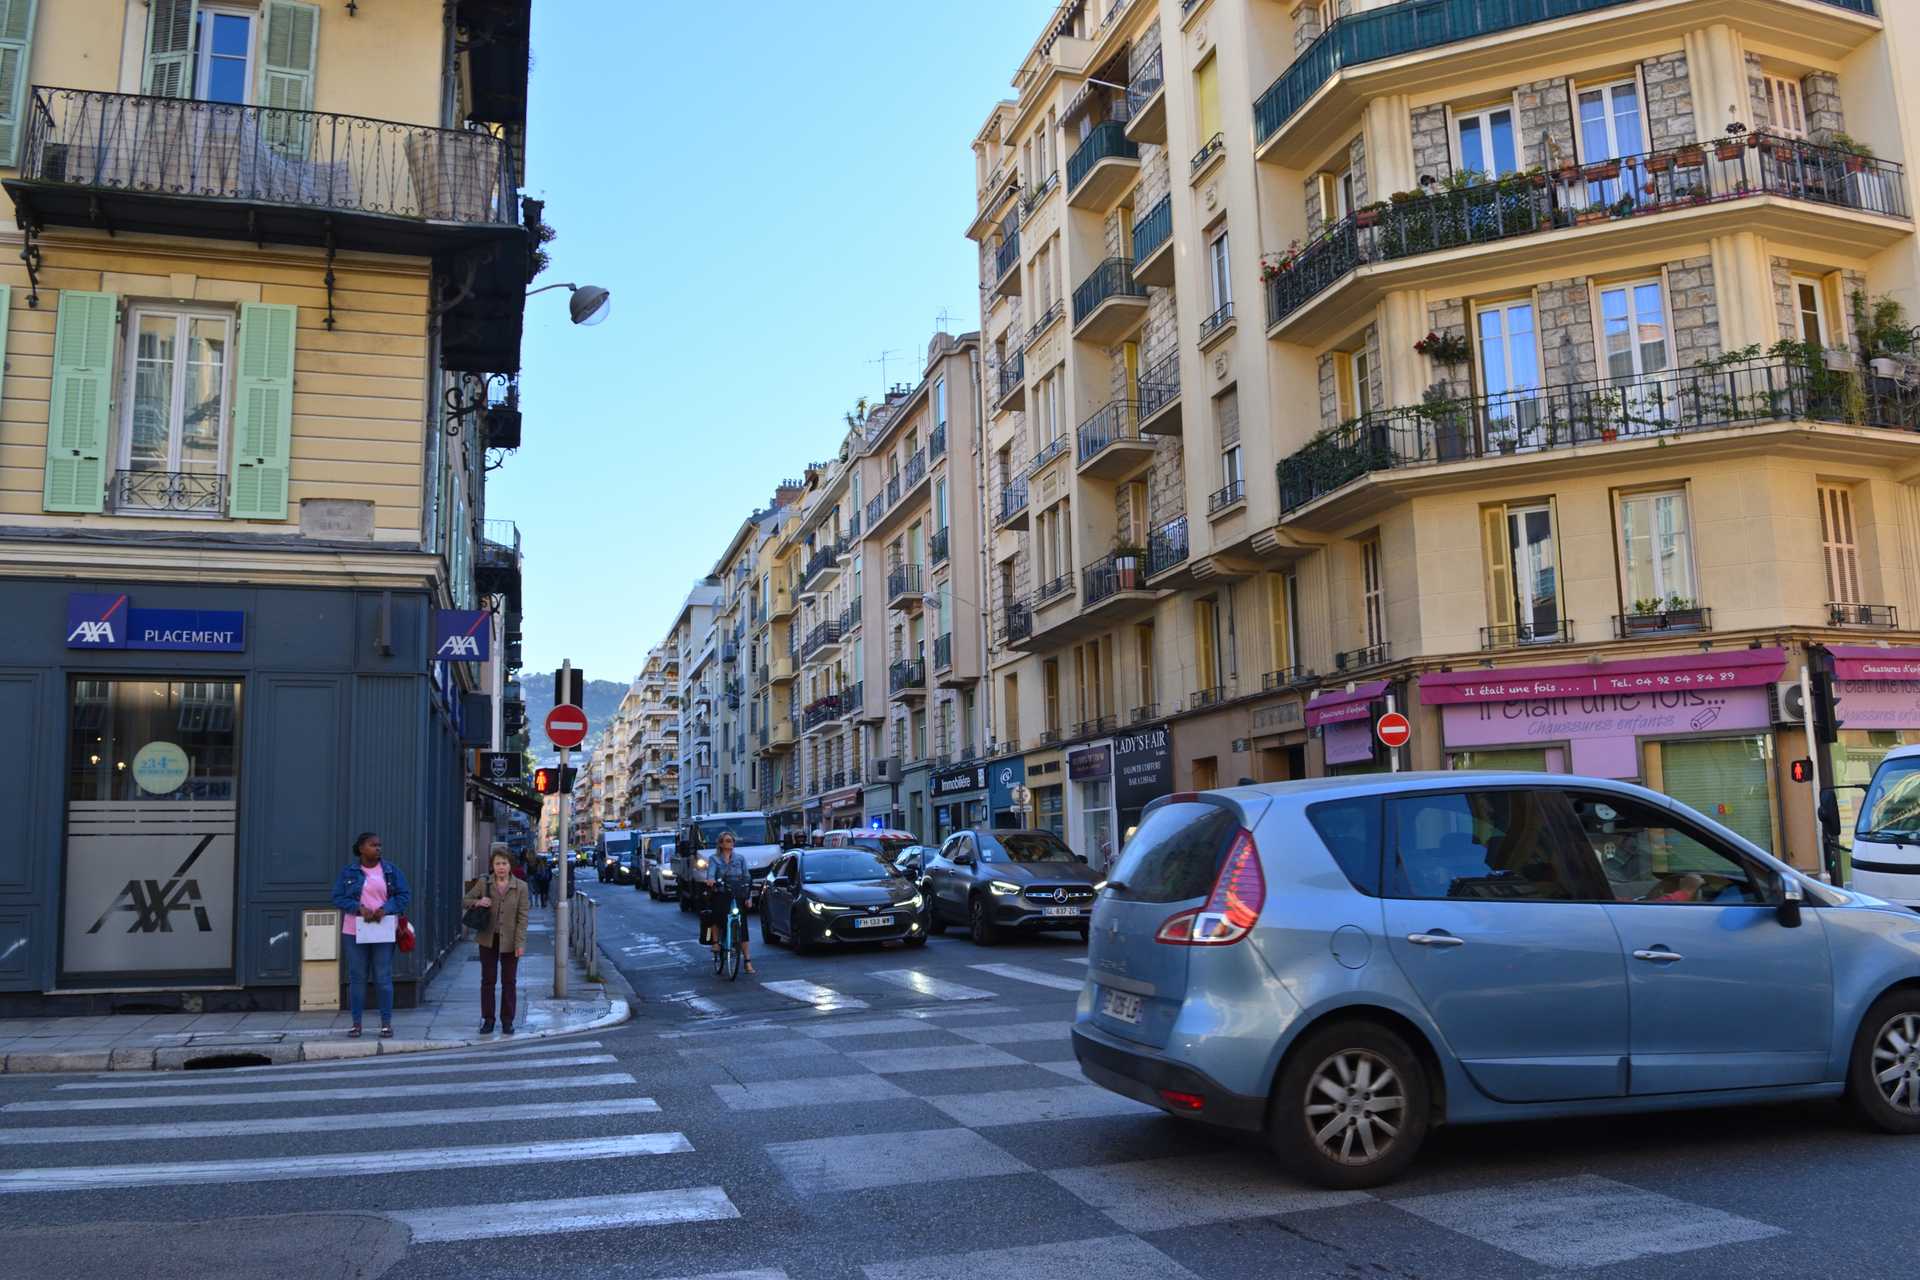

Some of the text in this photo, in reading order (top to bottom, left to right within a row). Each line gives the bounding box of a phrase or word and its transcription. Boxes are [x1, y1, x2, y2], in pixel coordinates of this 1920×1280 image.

[67, 621, 115, 643] AXA
[144, 629, 234, 644] PLACEMENT
[437, 635, 480, 656] AXA
[1464, 688, 1475, 696] Il
[1479, 685, 1505, 696] était
[1611, 672, 1735, 688] Tel. 04 92 04 84 89
[1581, 692, 1640, 714] une
[1527, 714, 1675, 735] Chaussures enfants
[1116, 736, 1144, 755] LADY'S
[86, 879, 213, 934] AXA
